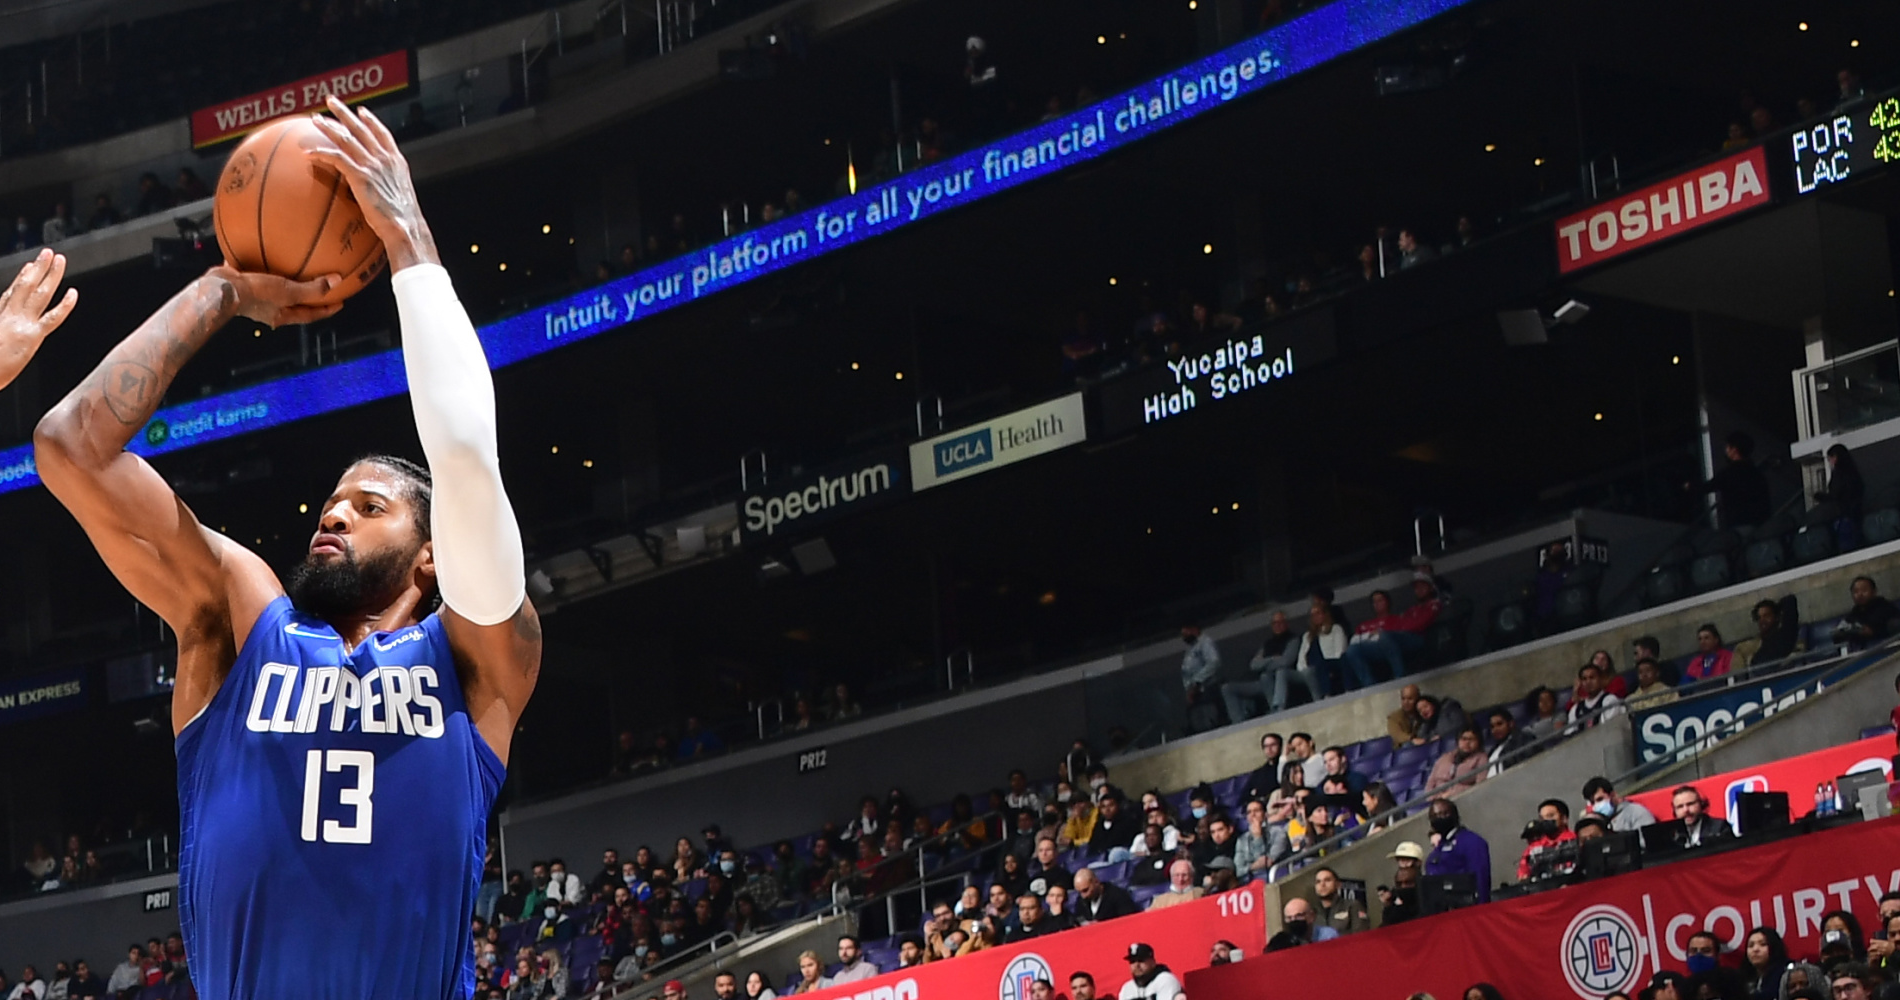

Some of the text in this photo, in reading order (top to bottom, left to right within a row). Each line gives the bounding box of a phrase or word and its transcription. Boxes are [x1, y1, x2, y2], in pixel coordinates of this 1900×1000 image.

[215, 65, 383, 131] WELLS FARGO
[1793, 97, 1900, 162] POR 42
[545, 50, 1281, 340] Intuit, your platform for all your financial challenges.
[1796, 150, 1851, 194] LAC
[1559, 160, 1763, 261] TOSHIBA
[1167, 335, 1264, 385] Yucaipa
[1211, 347, 1294, 400] School
[169, 411, 215, 440] credit
[216, 402, 268, 427] karma
[941, 413, 1064, 468] UCLA Health
[745, 464, 890, 535] Spectrum
[19, 679, 81, 706] EXPRESS
[246, 662, 445, 738] CLIPPERS
[800, 749, 827, 771] PR12
[301, 749, 375, 844] 13
[1217, 890, 1254, 917] 110
